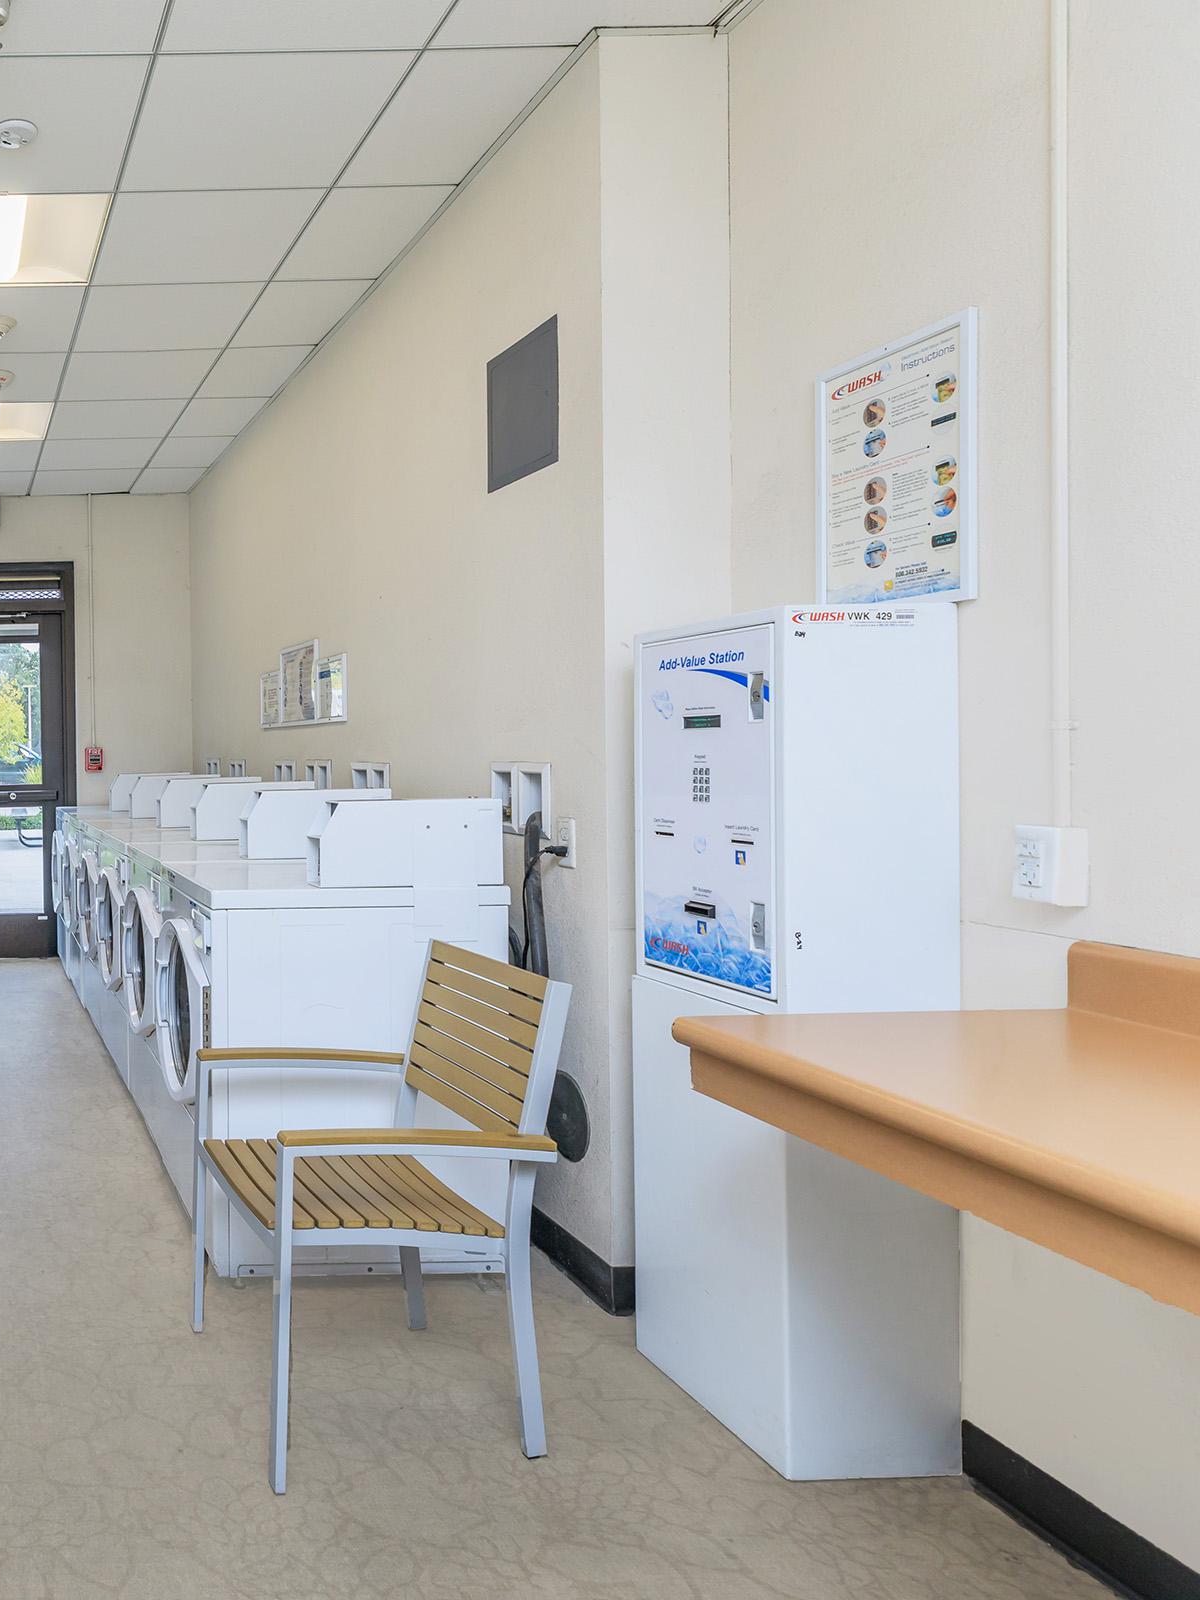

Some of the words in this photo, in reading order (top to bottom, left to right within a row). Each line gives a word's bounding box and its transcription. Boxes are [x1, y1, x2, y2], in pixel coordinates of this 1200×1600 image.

[901, 344, 955, 372] Instructions
[847, 370, 882, 394] WASH
[809, 612, 845, 622] WASH
[848, 612, 870, 620] VWK
[876, 612, 892, 620] 429
[659, 656, 706, 671] Add-Value
[709, 650, 744, 664] Station
[662, 940, 689, 956] WASH
